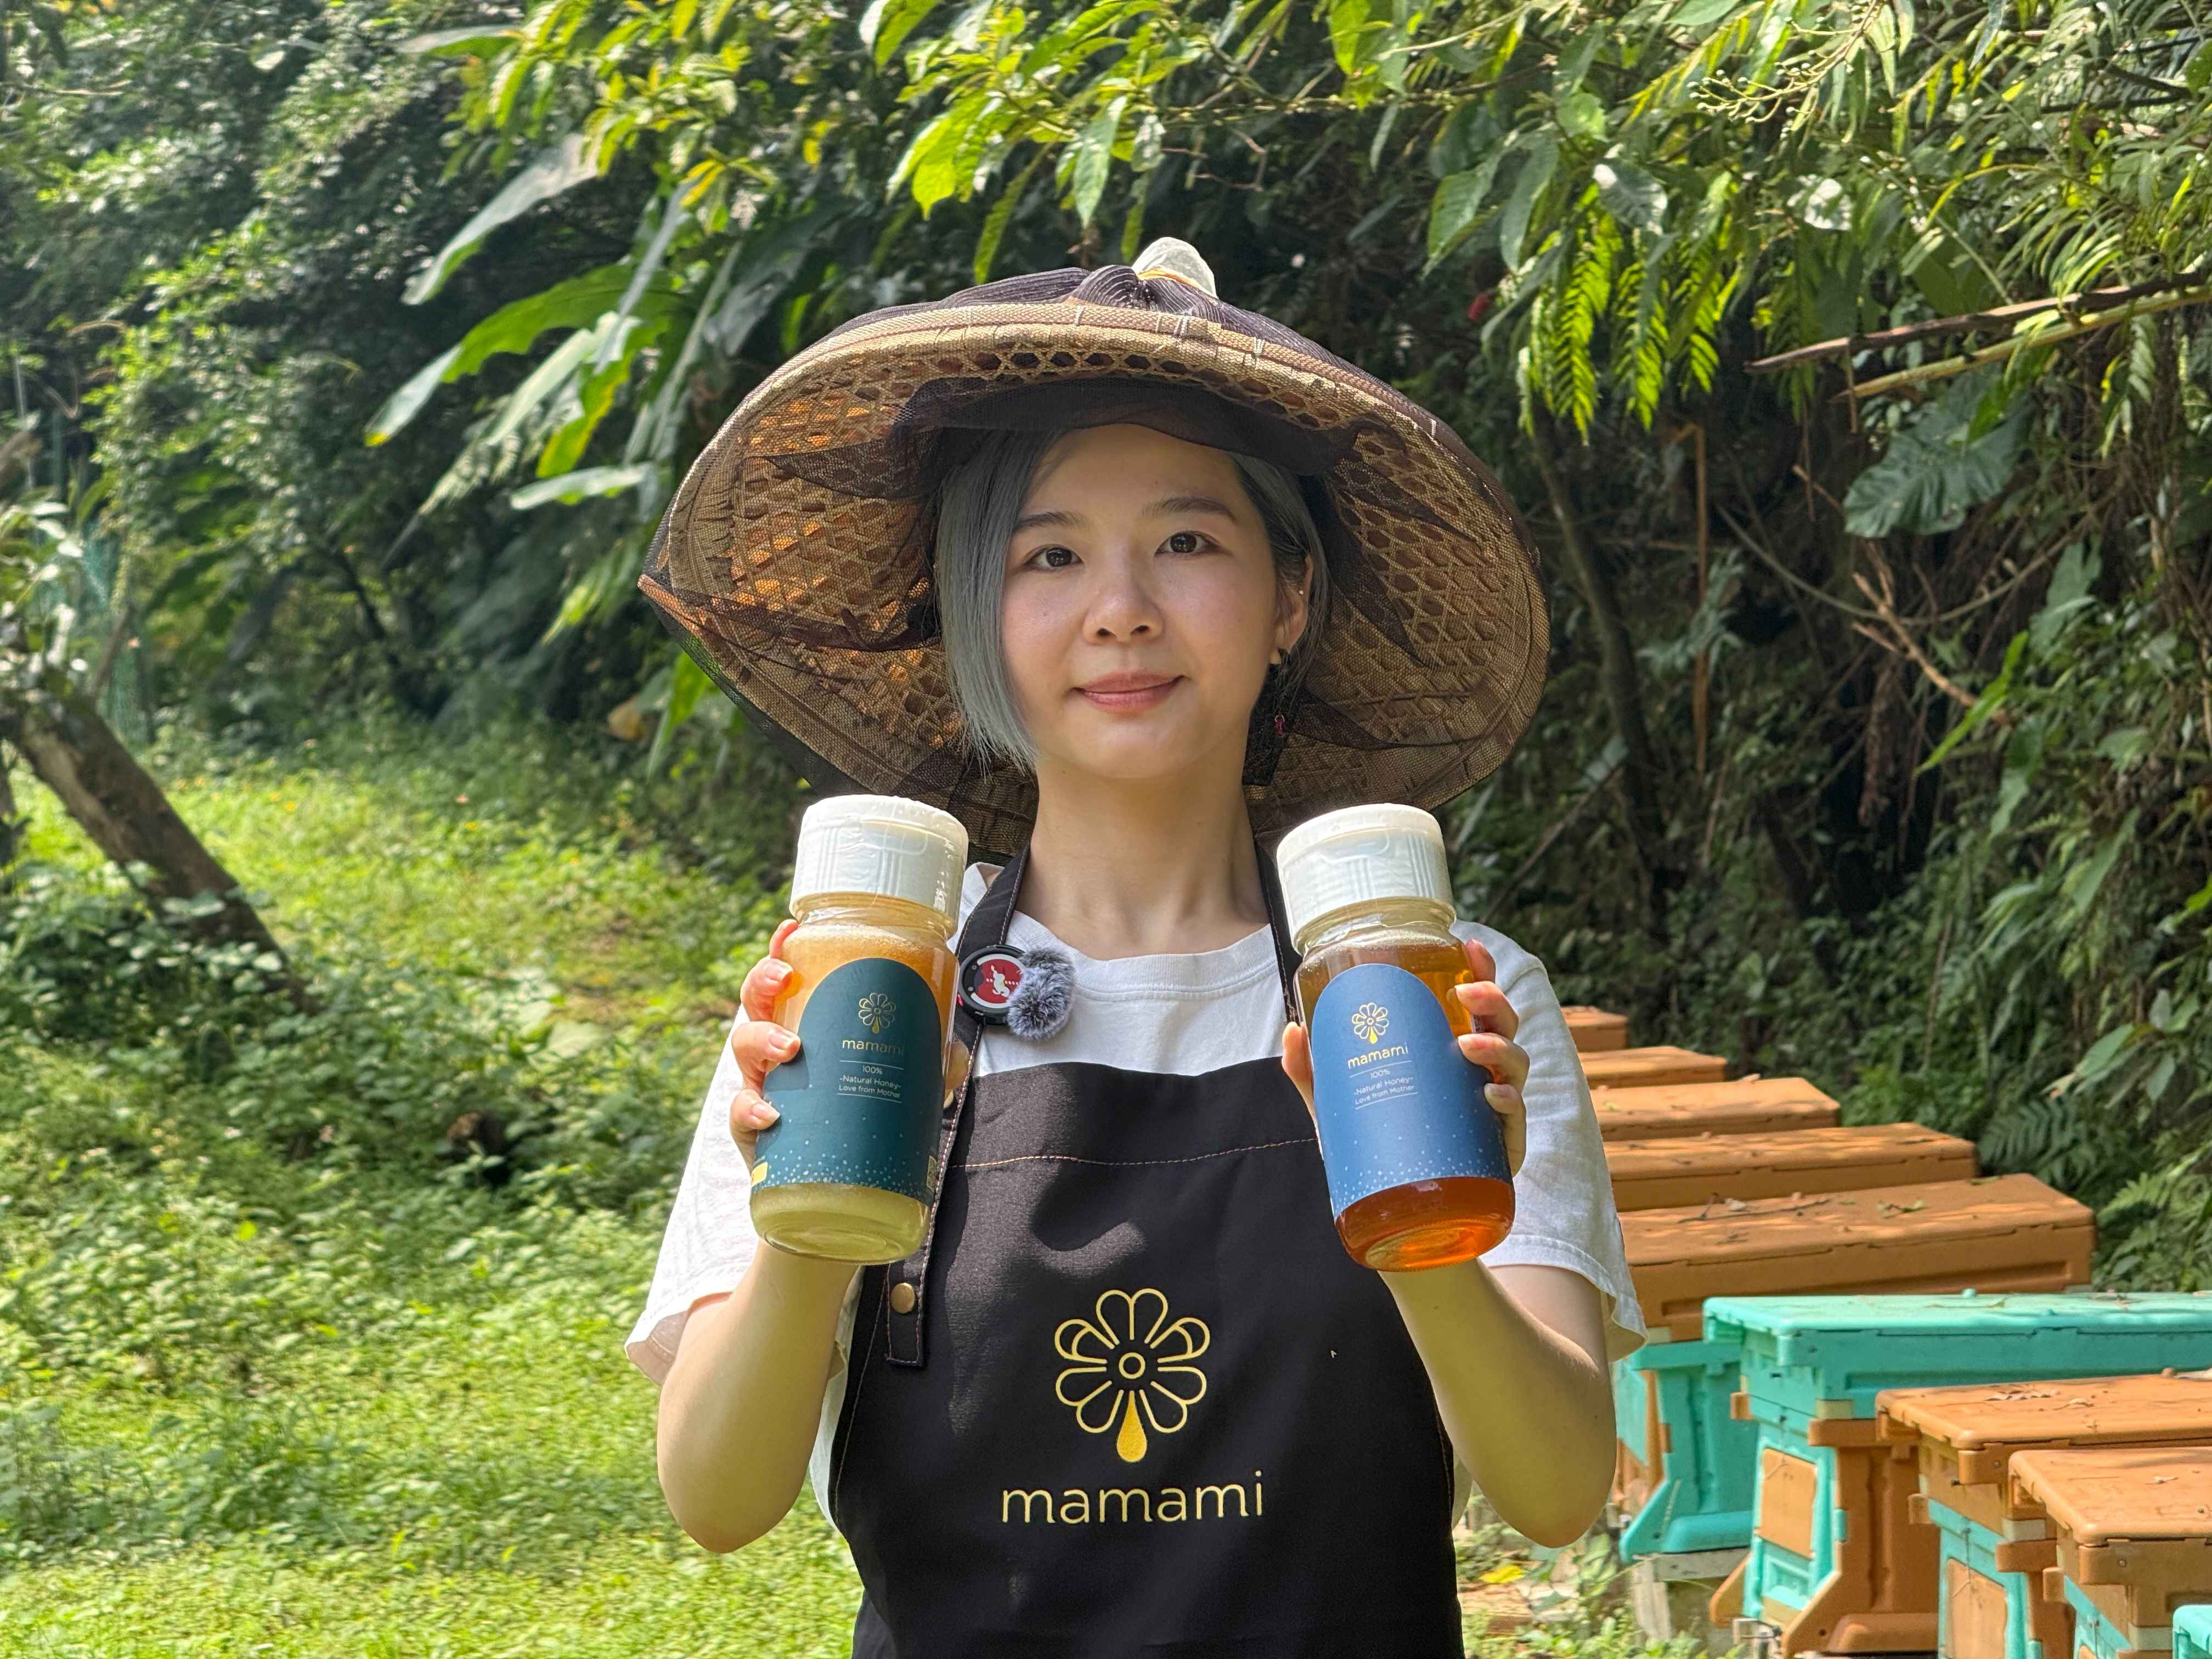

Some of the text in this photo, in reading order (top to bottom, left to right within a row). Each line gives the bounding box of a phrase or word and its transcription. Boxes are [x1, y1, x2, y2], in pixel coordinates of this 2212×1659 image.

[842, 1039, 904, 1055] mamami
[1347, 1042, 1408, 1069] mamami
[862, 1065, 883, 1075] 100%
[1370, 1069, 1391, 1079] 100%
[839, 1084, 856, 1092] Love
[859, 1085, 875, 1093] from
[1355, 1085, 1414, 1105] Love from Mother
[1002, 1470, 1262, 1524] mamami
